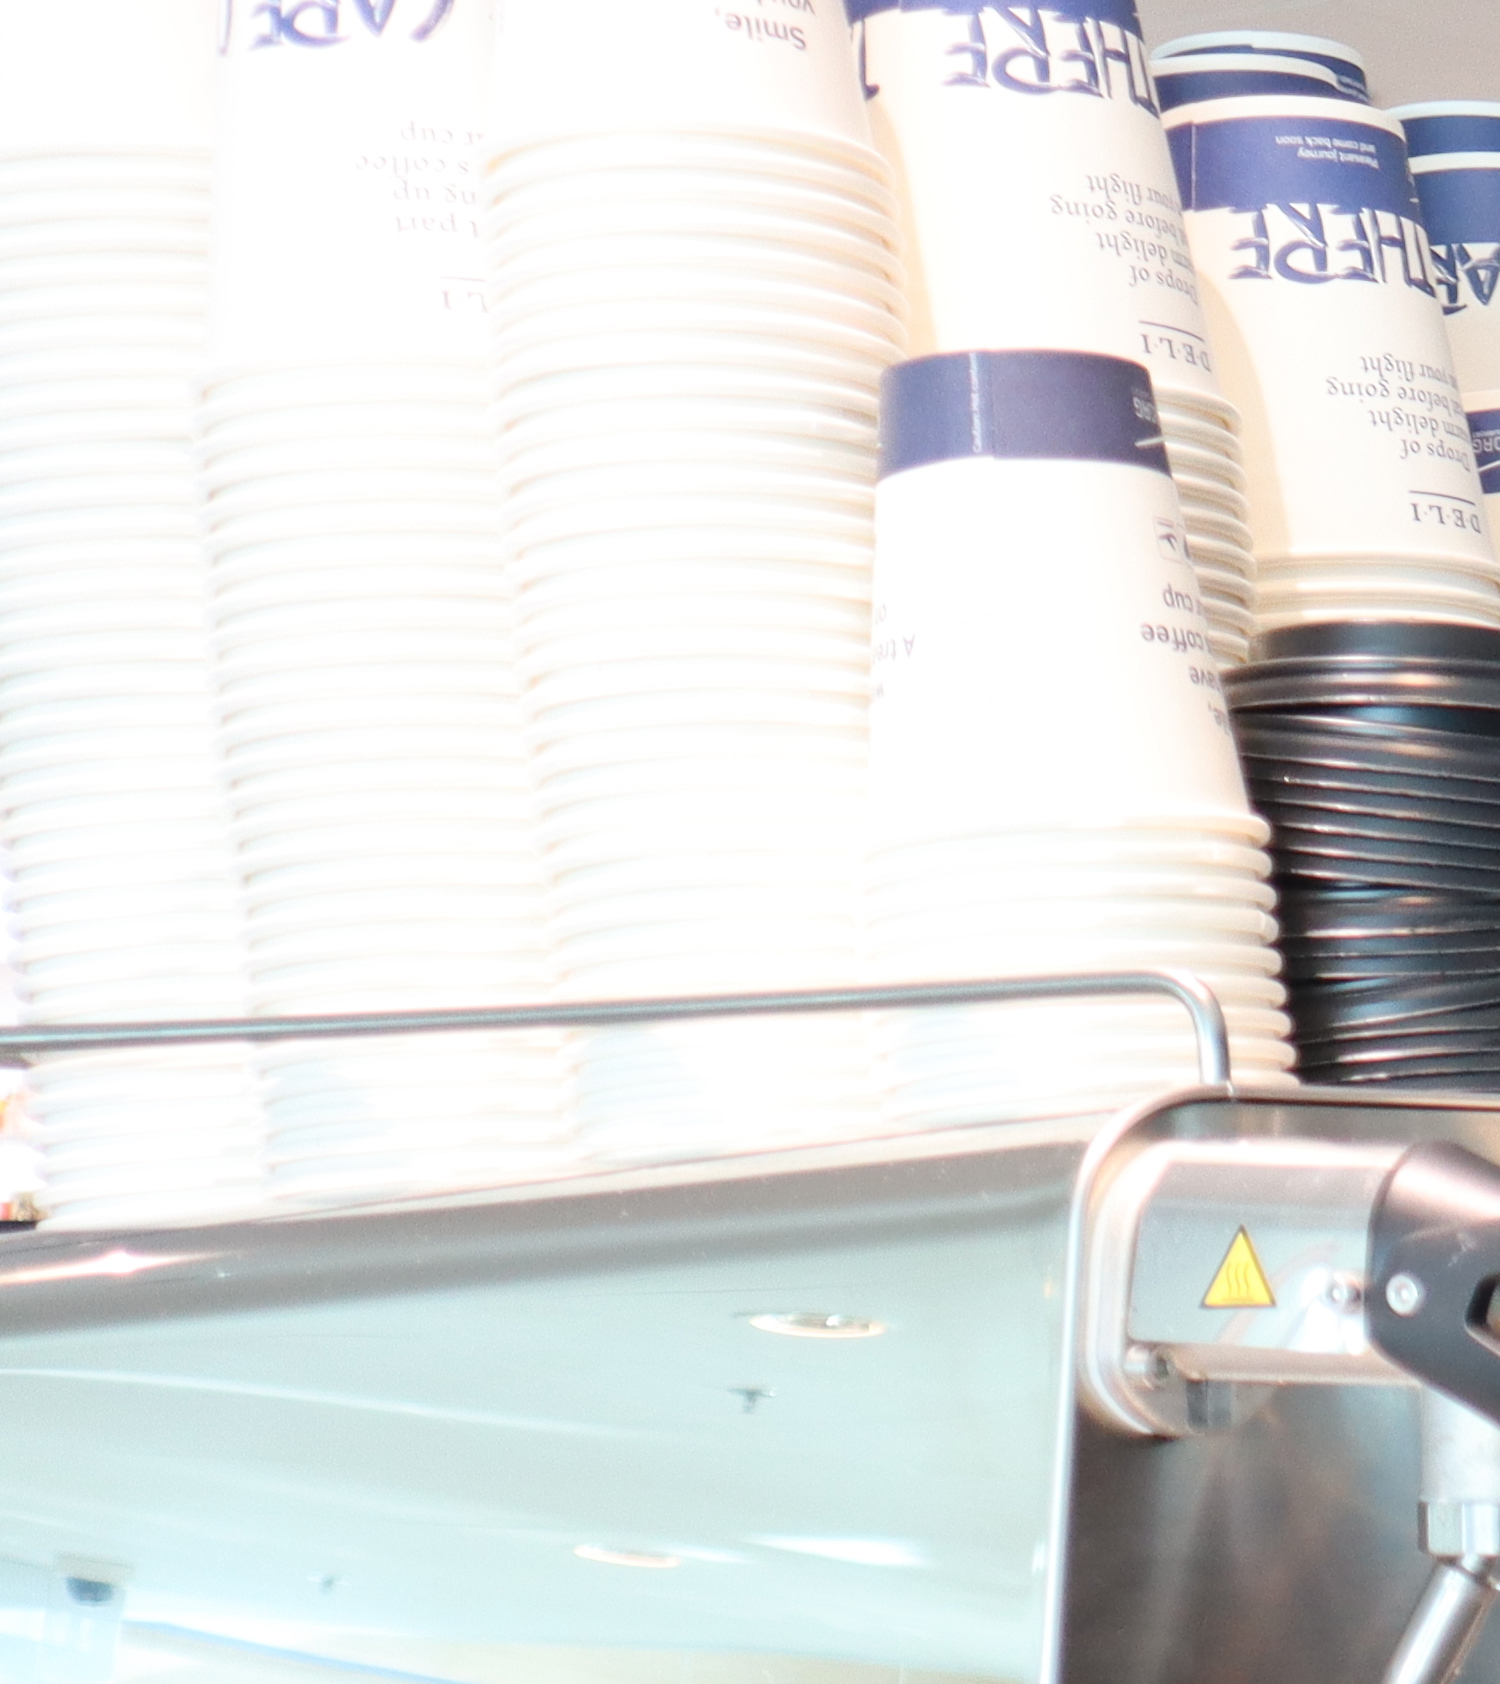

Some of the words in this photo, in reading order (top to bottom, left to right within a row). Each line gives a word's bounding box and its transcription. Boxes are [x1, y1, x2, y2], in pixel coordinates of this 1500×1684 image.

[714, 8, 808, 51] Smile,
[1086, 173, 1141, 206] flight
[1050, 194, 1117, 224] going
[1124, 209, 1177, 240] before
[1096, 231, 1168, 266] delight
[1128, 265, 1150, 287] of
[1360, 353, 1414, 382] flight
[1325, 376, 1390, 402] going
[1396, 387, 1450, 411] before
[1368, 406, 1439, 438] delight
[1400, 439, 1421, 460] of
[1427, 439, 1471, 473] Drops
[1161, 583, 1193, 614] cup
[1140, 622, 1204, 655] coffee
